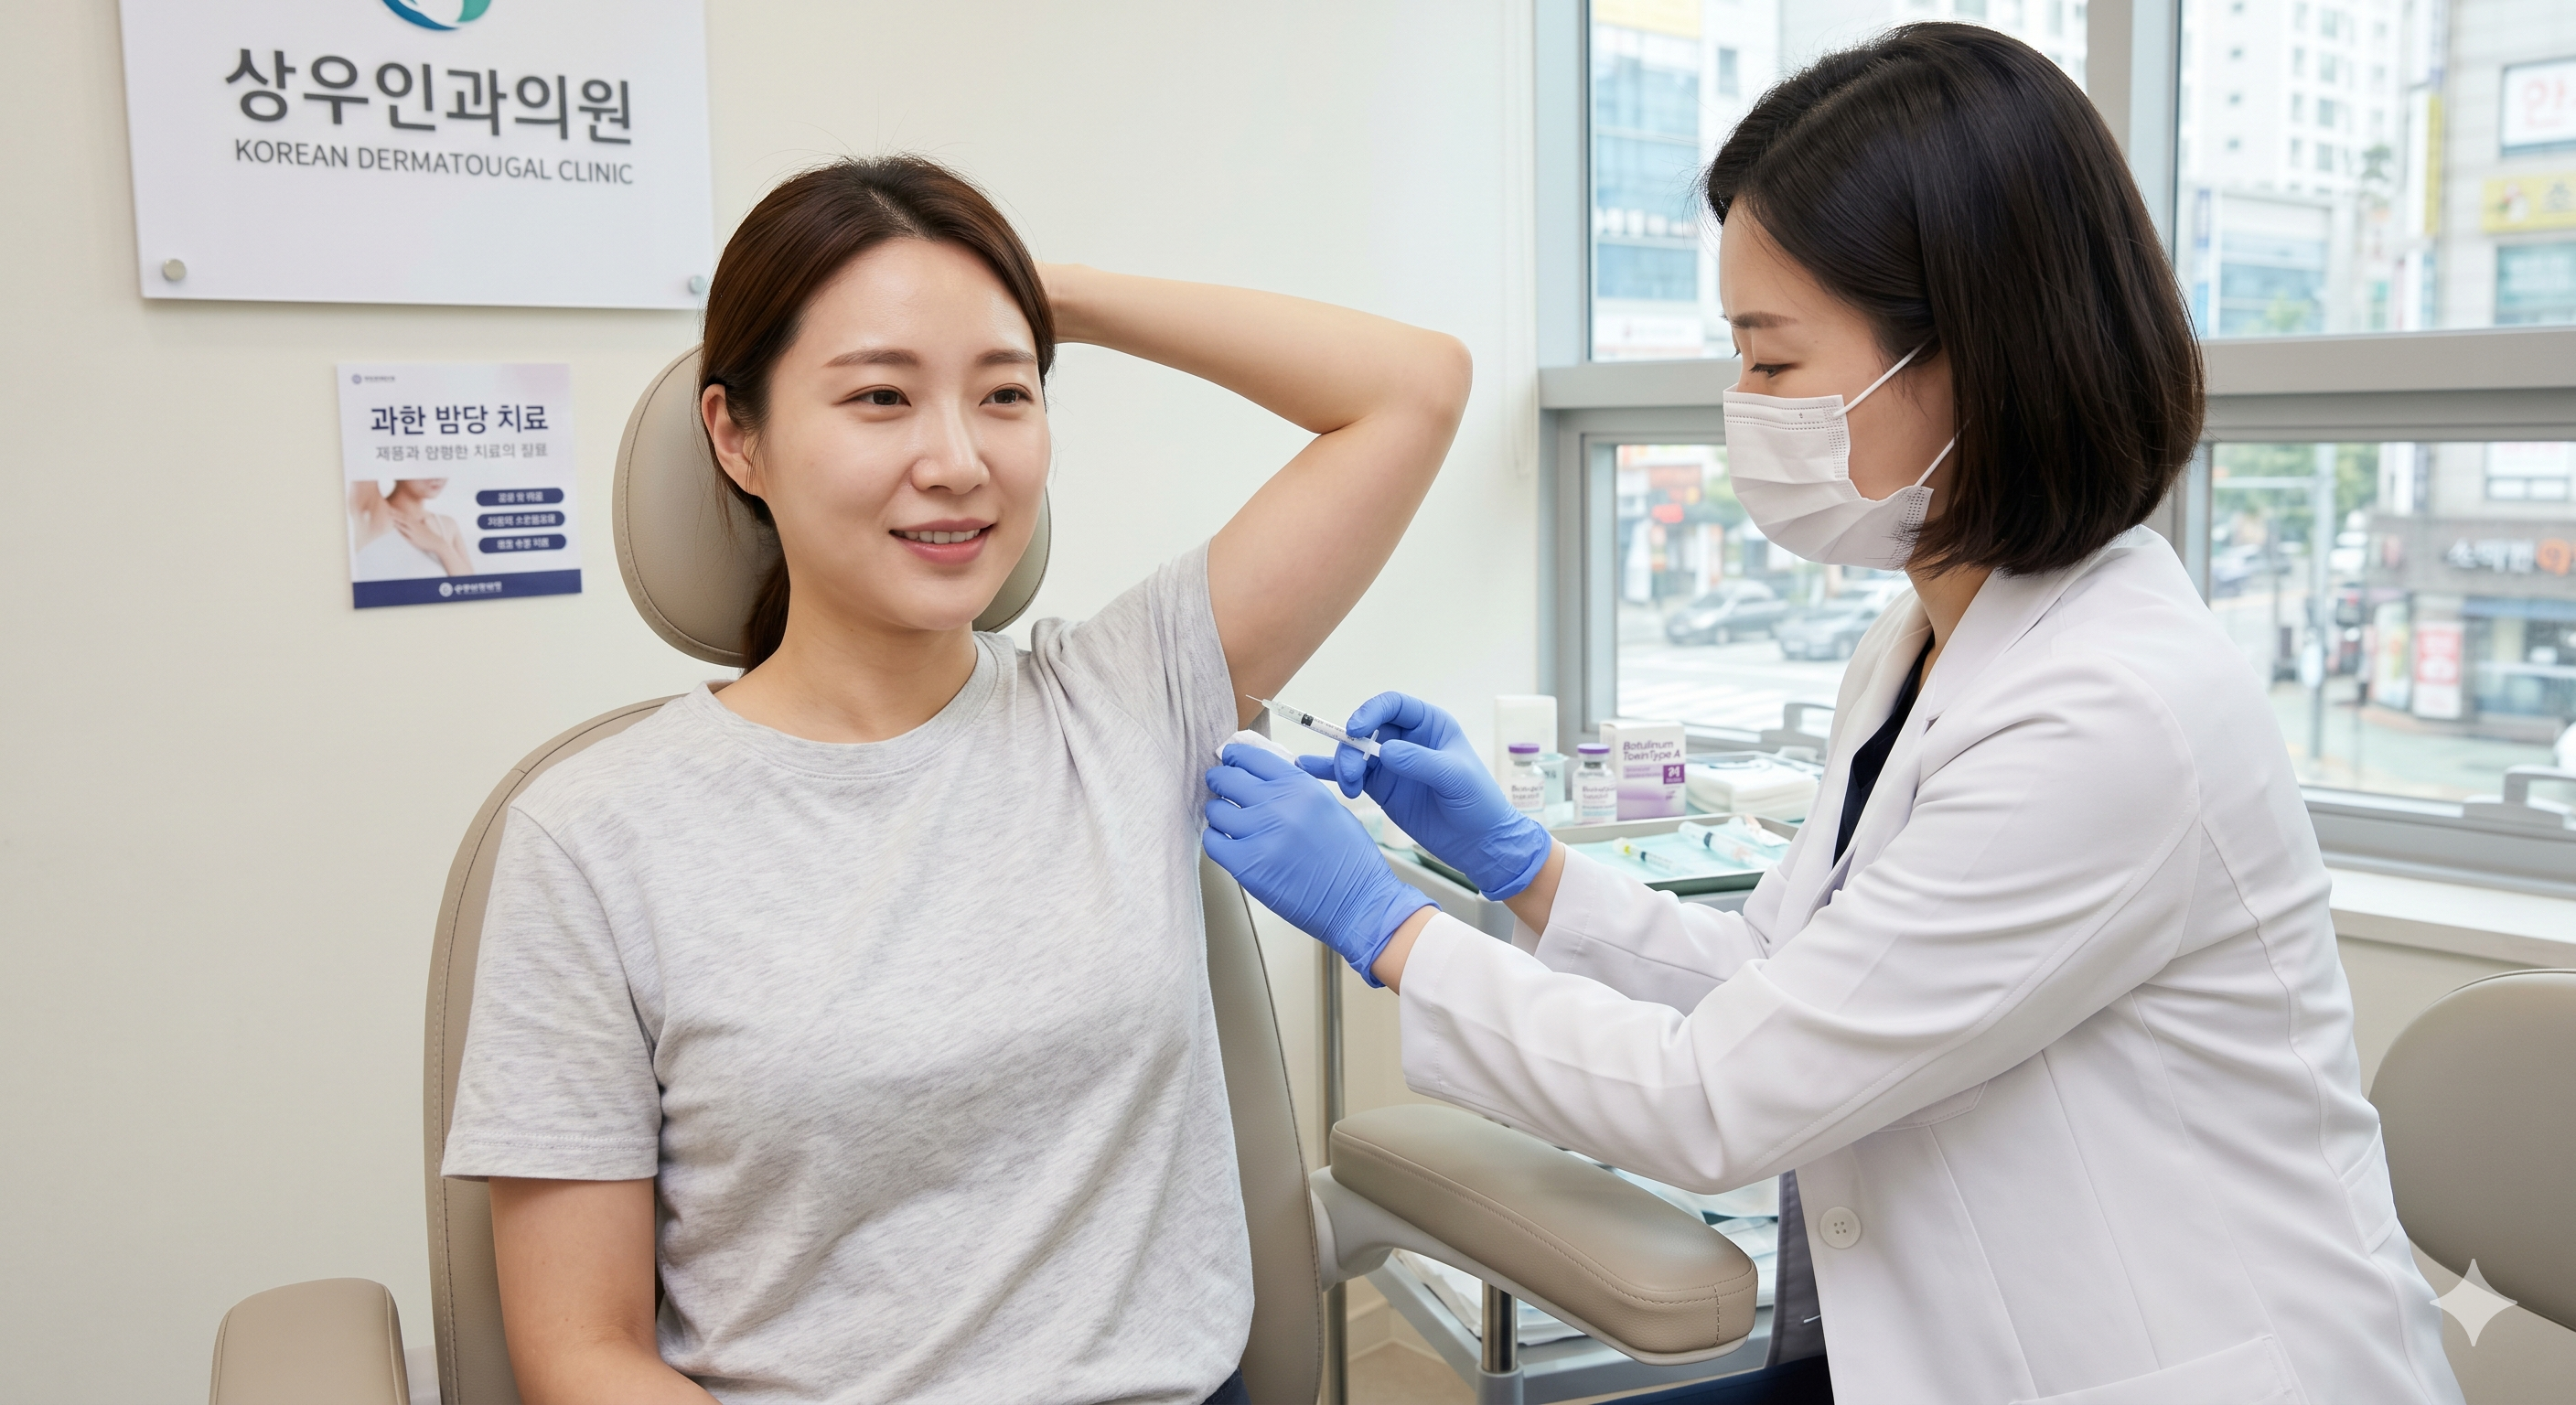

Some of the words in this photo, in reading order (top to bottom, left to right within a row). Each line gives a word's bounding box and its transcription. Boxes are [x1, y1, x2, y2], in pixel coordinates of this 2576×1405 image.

[225, 48, 632, 145] 상우인과의원
[234, 138, 349, 168] KOREAN
[357, 146, 553, 181] DERMATOUGAL
[557, 159, 633, 186] CLINIC
[370, 405, 426, 436] 과한
[435, 404, 488, 434] 밤당
[497, 404, 549, 434] 치료
[474, 443, 516, 460] 치료의
